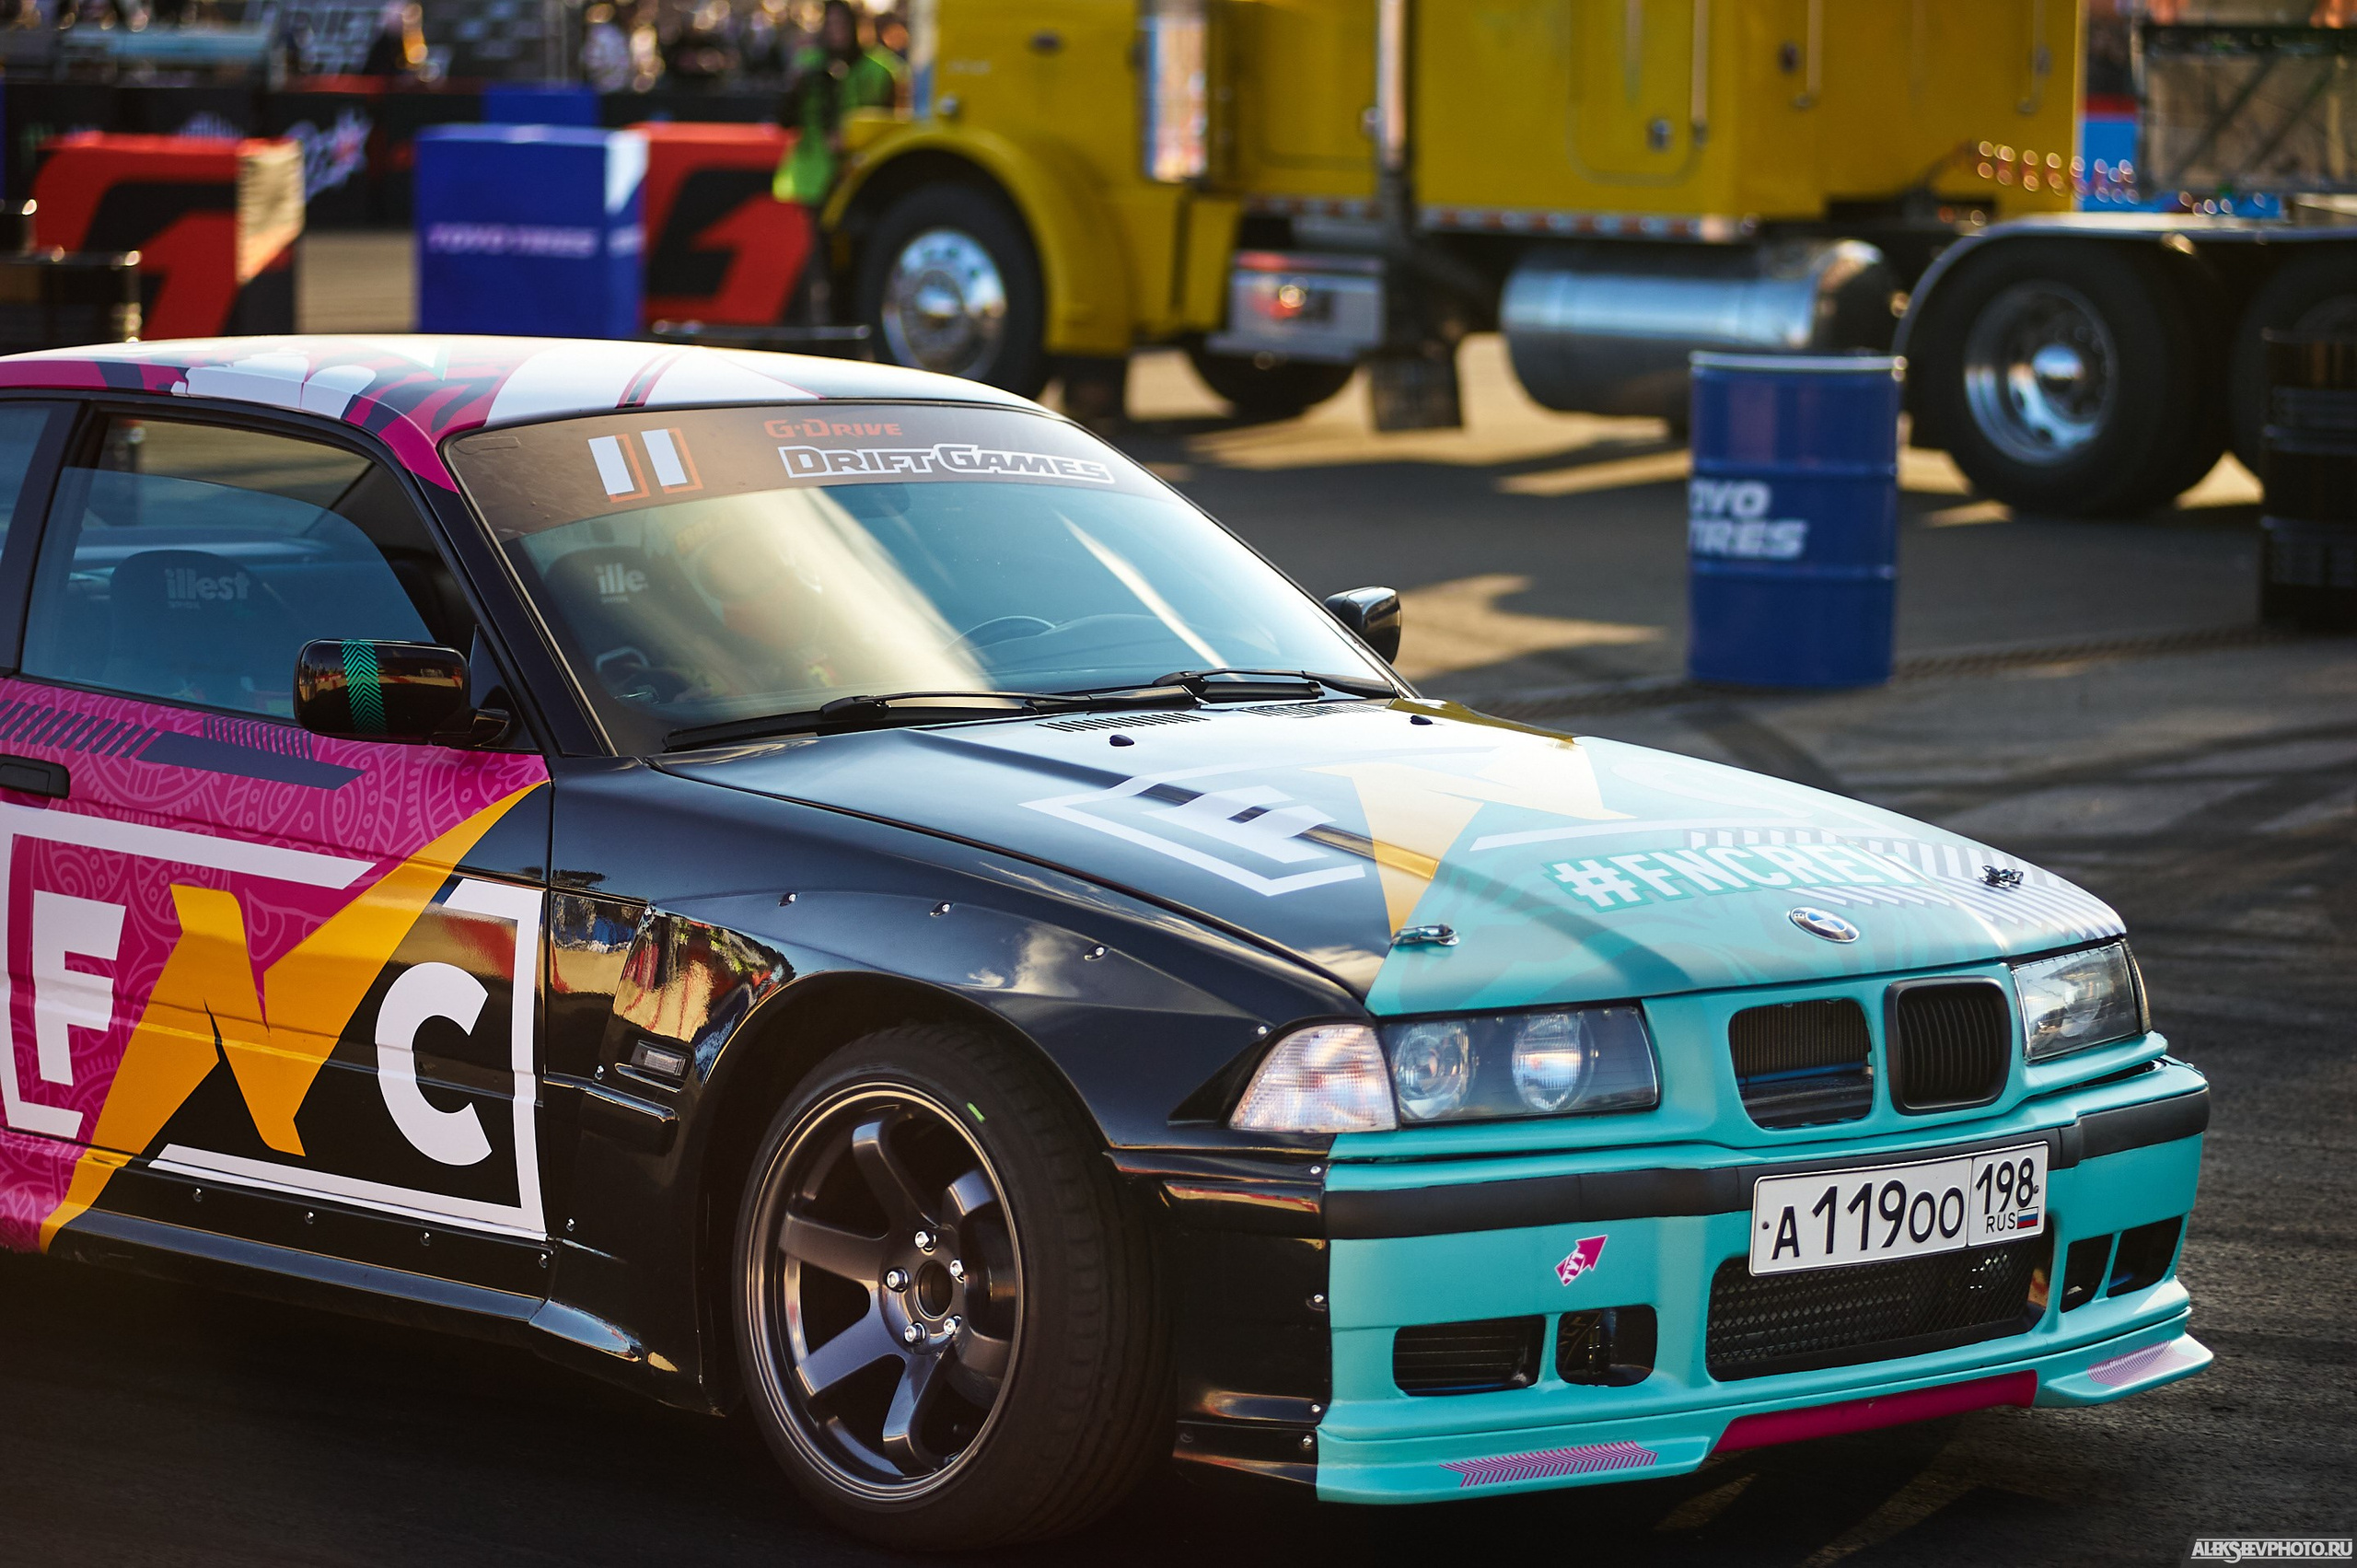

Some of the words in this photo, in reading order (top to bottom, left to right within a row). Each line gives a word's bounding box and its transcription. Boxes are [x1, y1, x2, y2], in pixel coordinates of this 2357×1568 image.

[165, 568, 250, 600] illest
[594, 563, 650, 595] ille
[1975, 1156, 2034, 1215] 198
[1985, 1212, 2016, 1234] RUS
